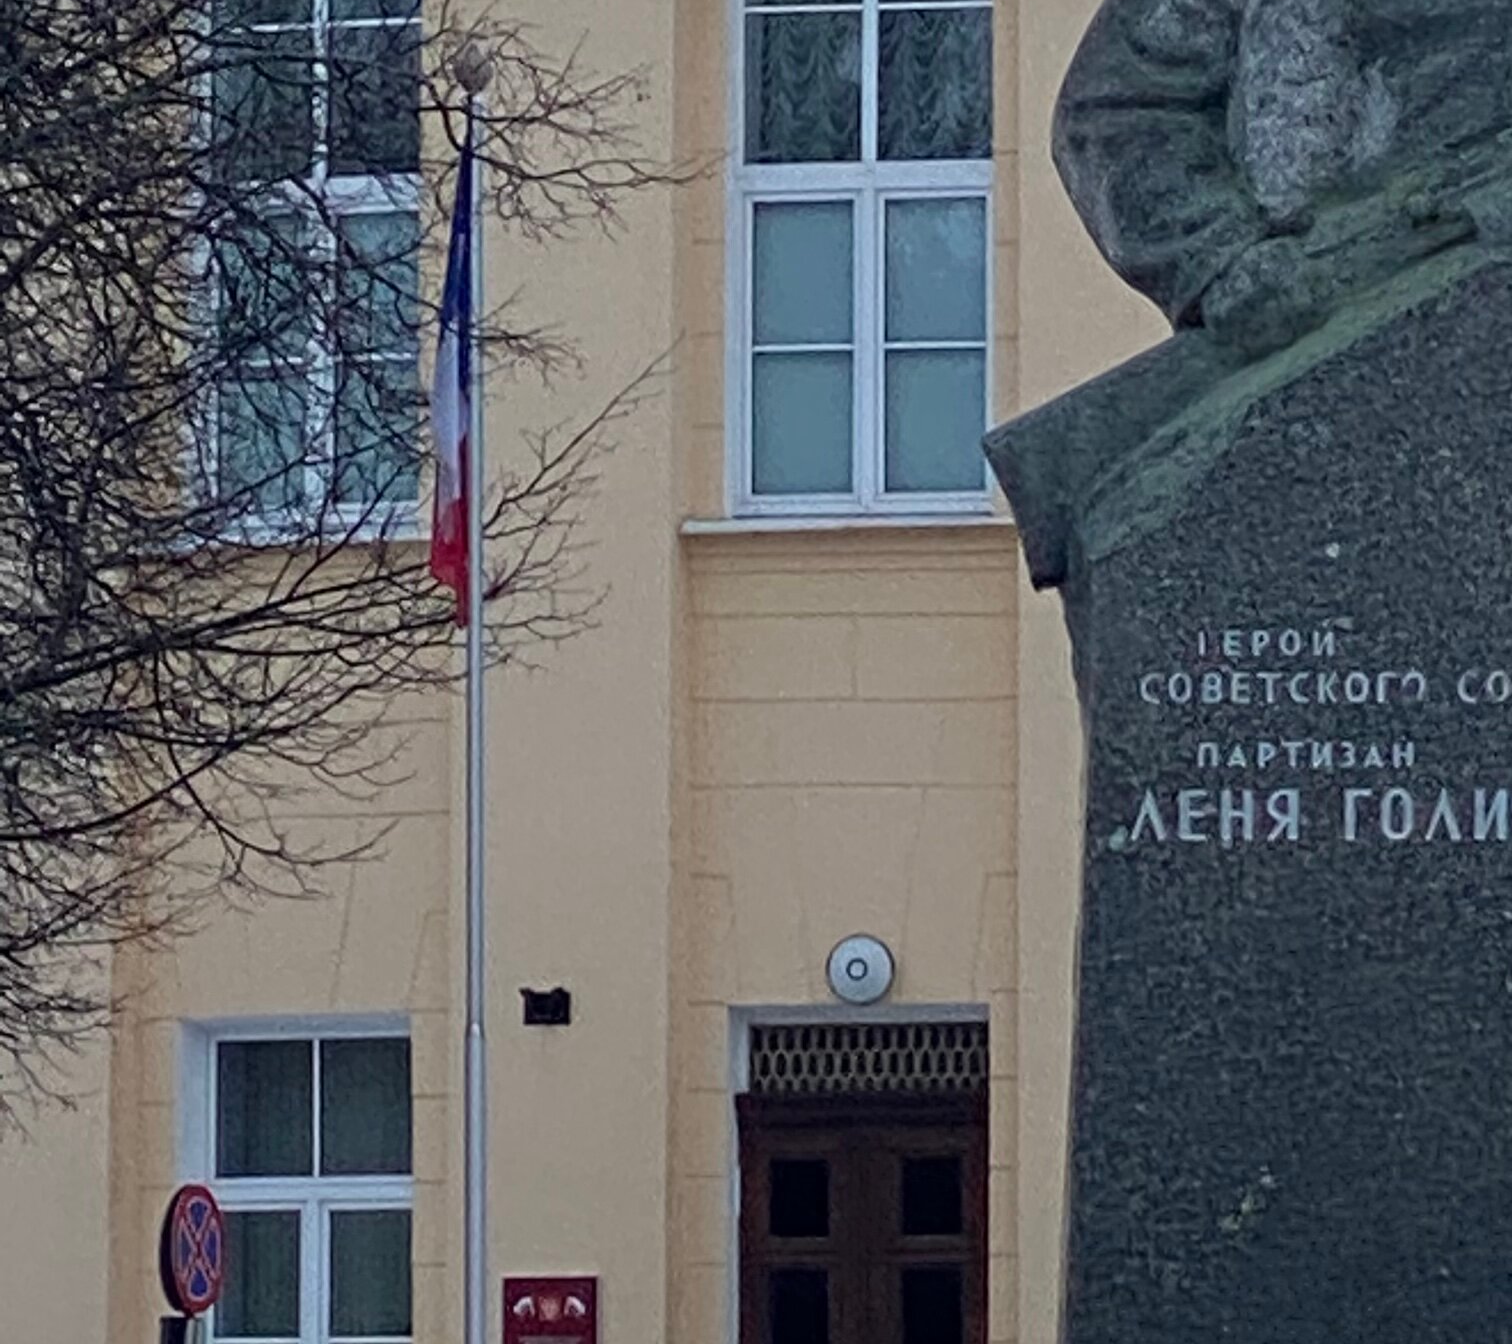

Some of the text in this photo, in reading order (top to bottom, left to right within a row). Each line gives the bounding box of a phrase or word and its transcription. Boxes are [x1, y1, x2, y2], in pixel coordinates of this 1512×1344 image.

[1139, 670, 1427, 705] СОВЕТСКОГО
[1197, 739, 1416, 769] ПАРТИЗАН
[1131, 787, 1301, 842] ЛЕНЯ
